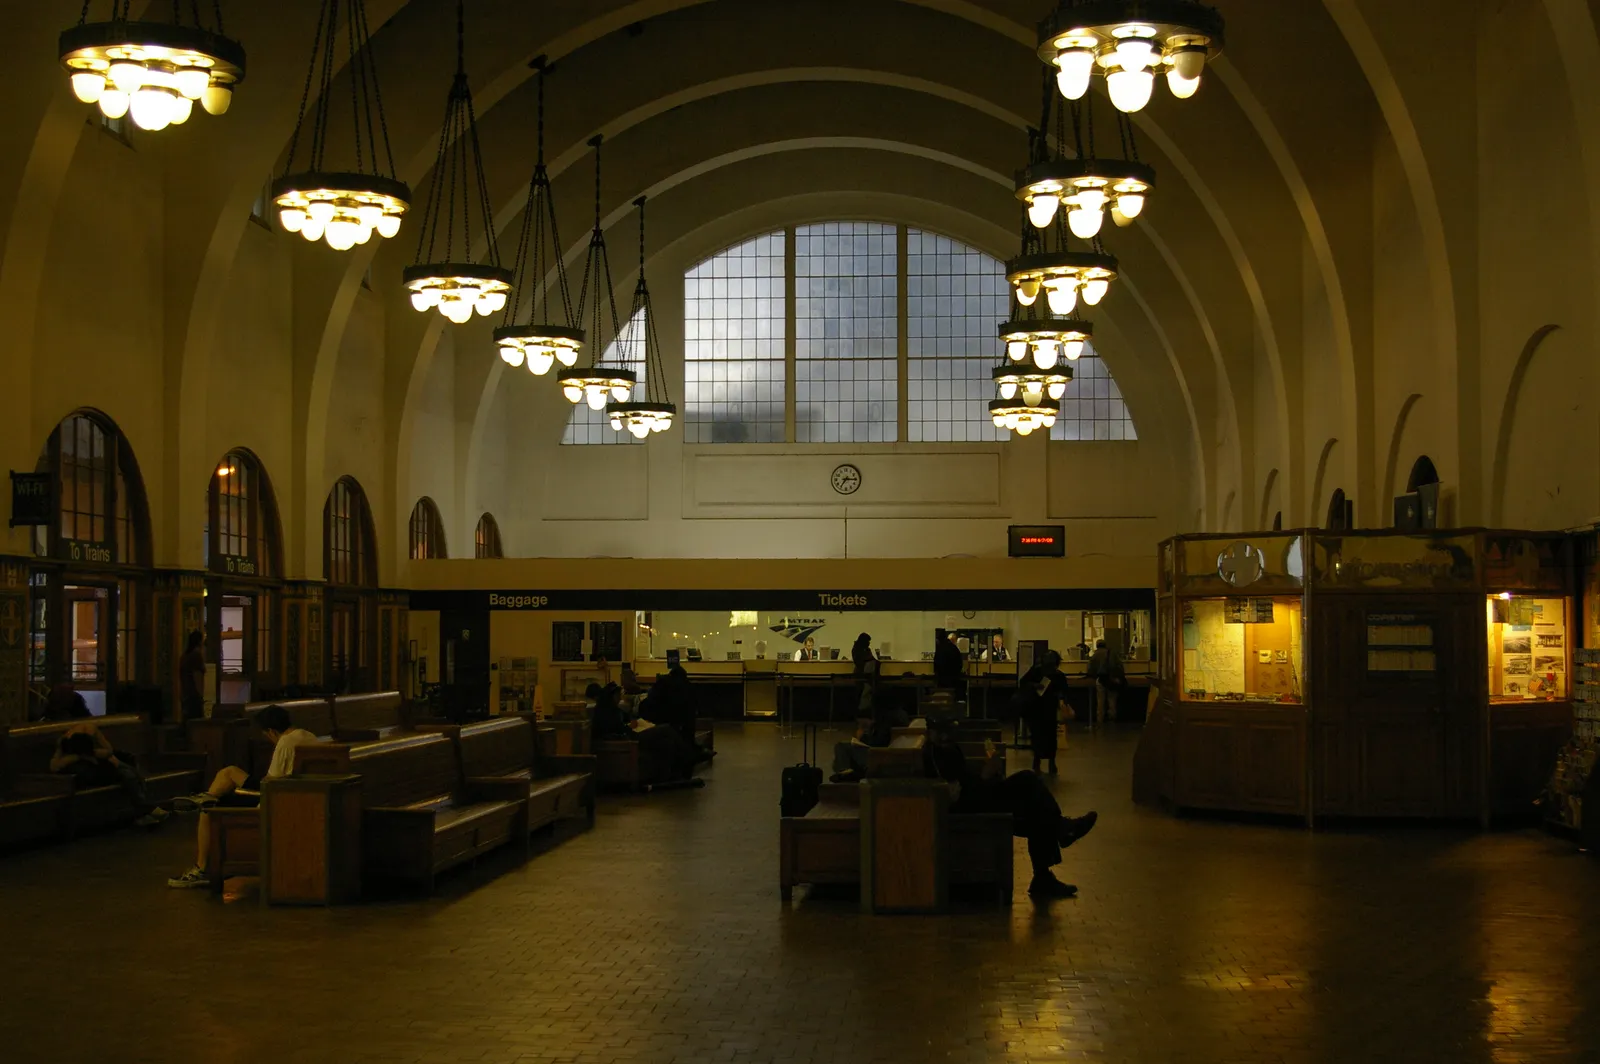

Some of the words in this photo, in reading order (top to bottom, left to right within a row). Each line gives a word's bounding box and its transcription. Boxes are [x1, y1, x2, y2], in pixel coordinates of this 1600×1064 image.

[69, 541, 80, 560] To
[83, 543, 110, 562] Trains
[226, 557, 234, 573] To
[489, 593, 548, 608] Baggage
[818, 593, 867, 606] Tickets
